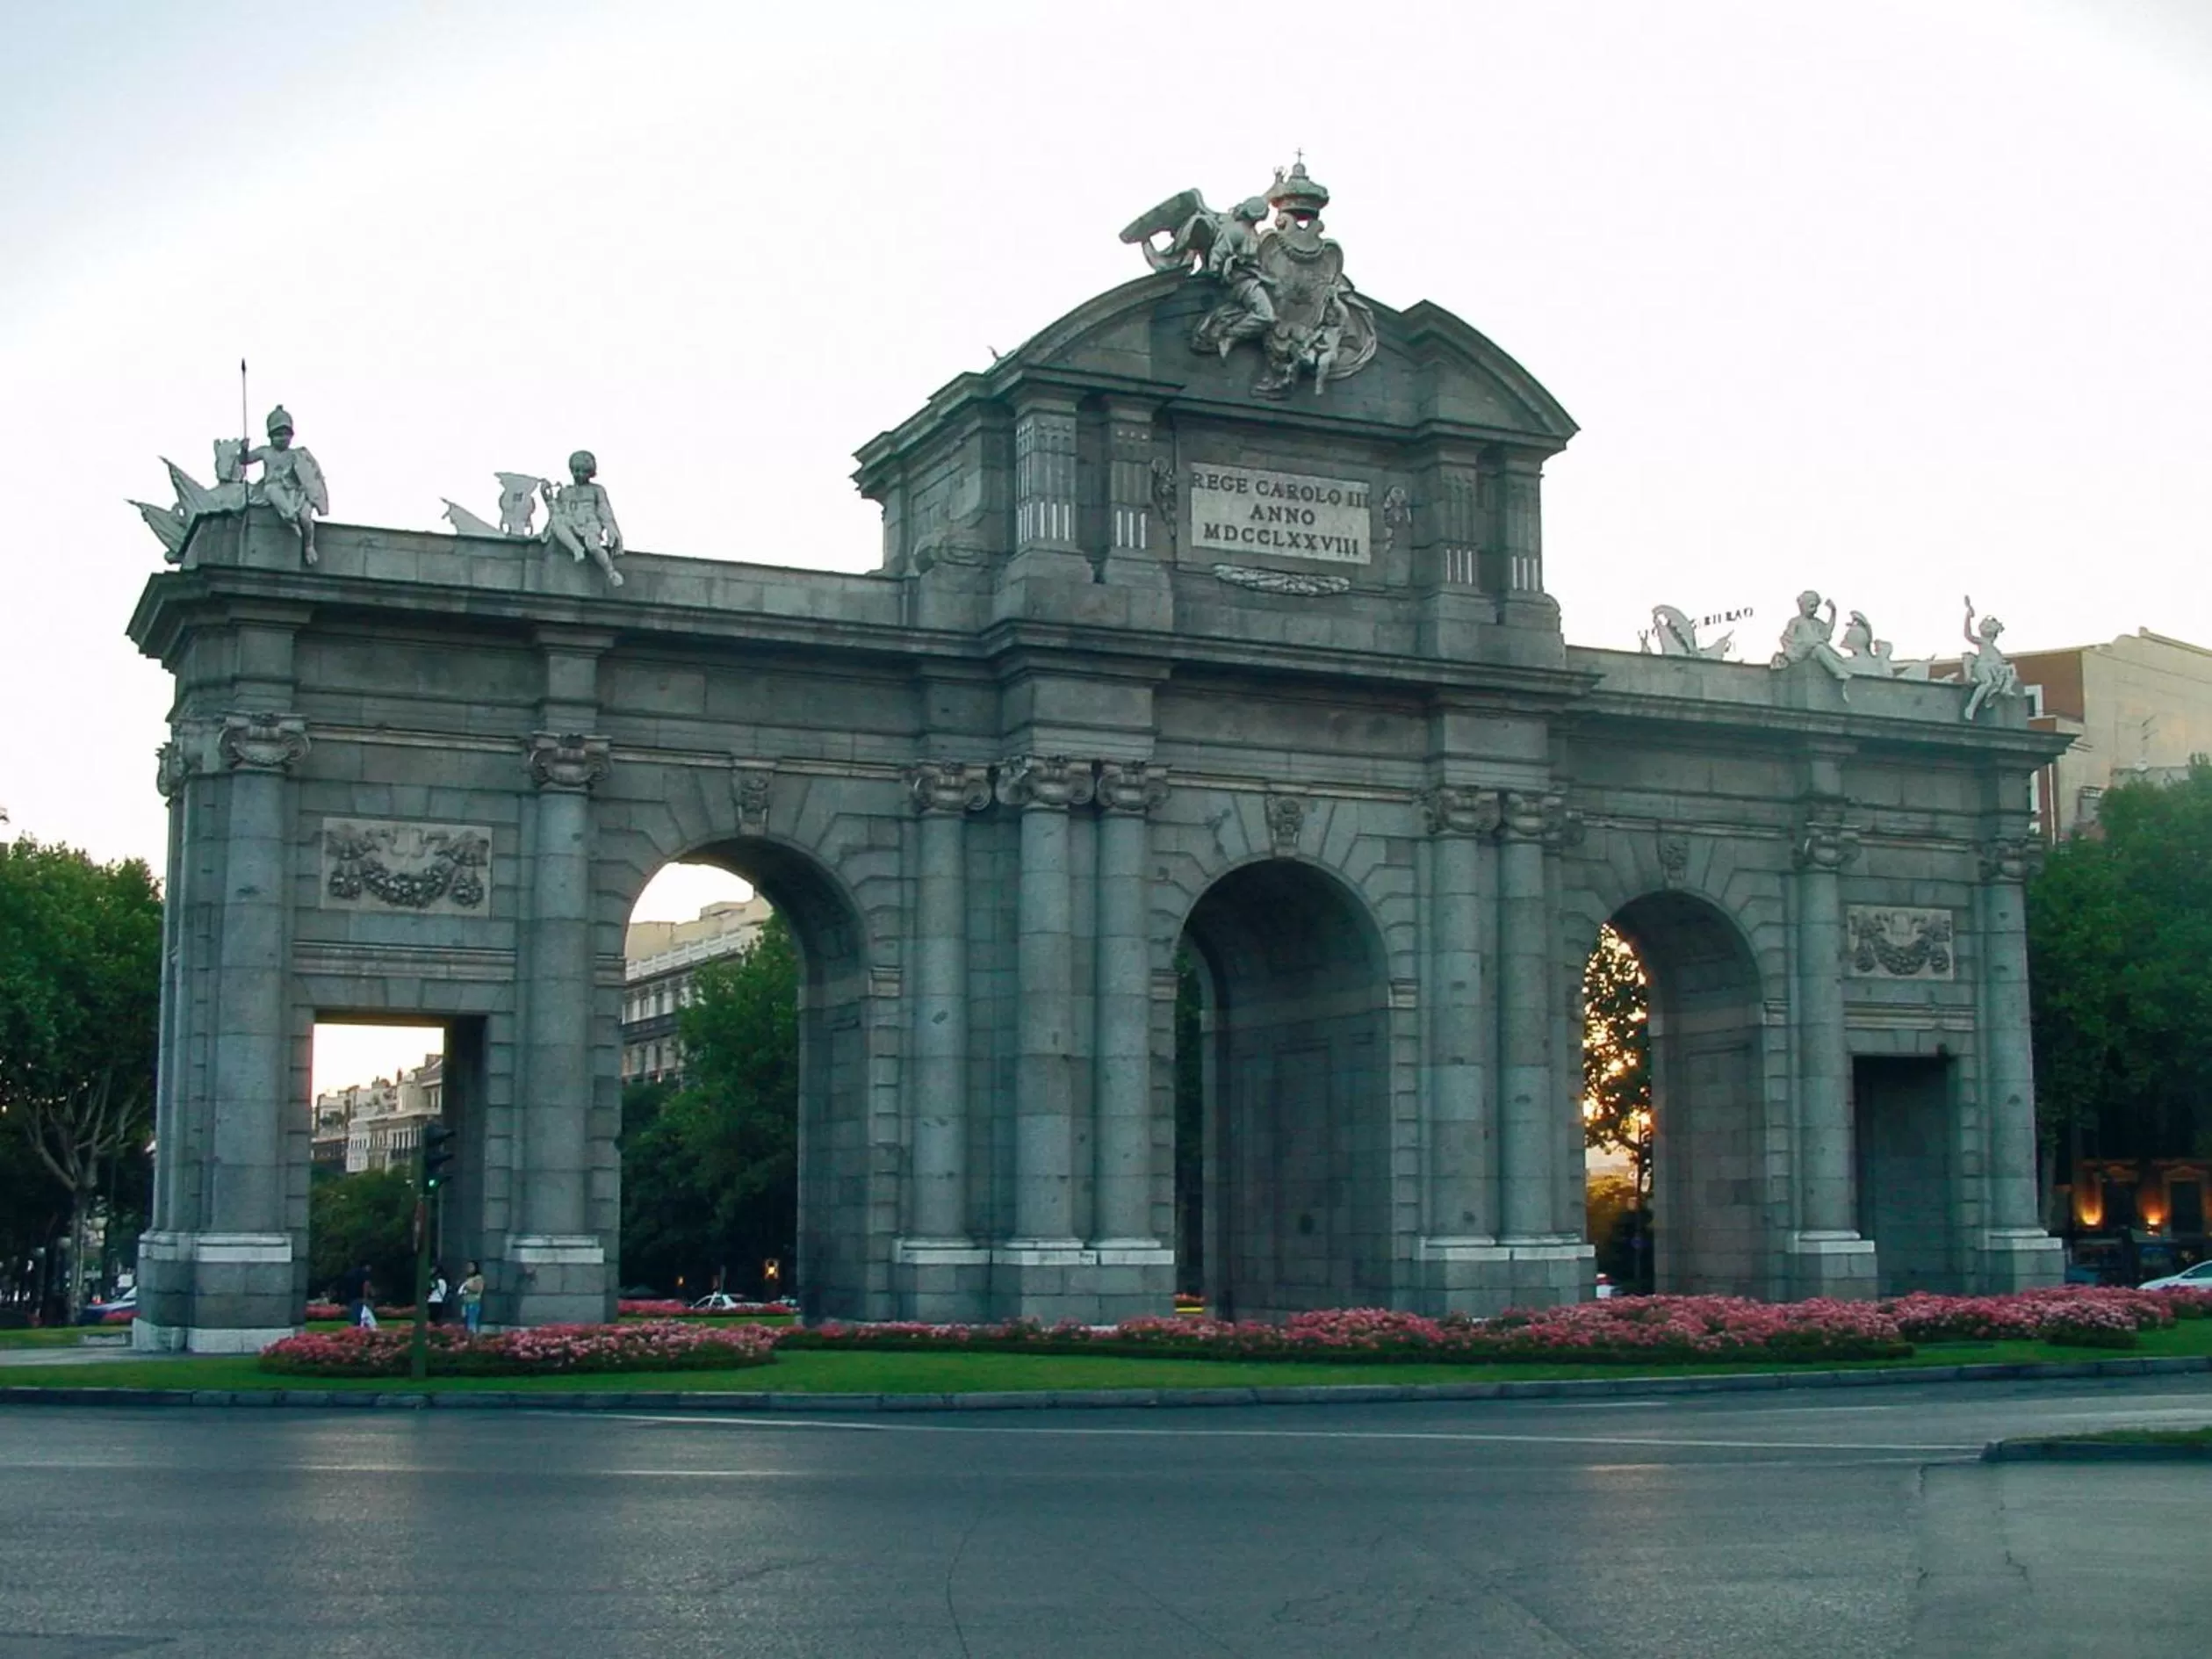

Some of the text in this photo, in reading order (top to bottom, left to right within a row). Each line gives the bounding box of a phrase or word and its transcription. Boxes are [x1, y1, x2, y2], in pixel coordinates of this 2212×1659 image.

[1191, 471, 1369, 509] REGE CAROLO III
[1250, 503, 1315, 525] ANNO
[1203, 523, 1359, 556] MDCCLXXVIII
